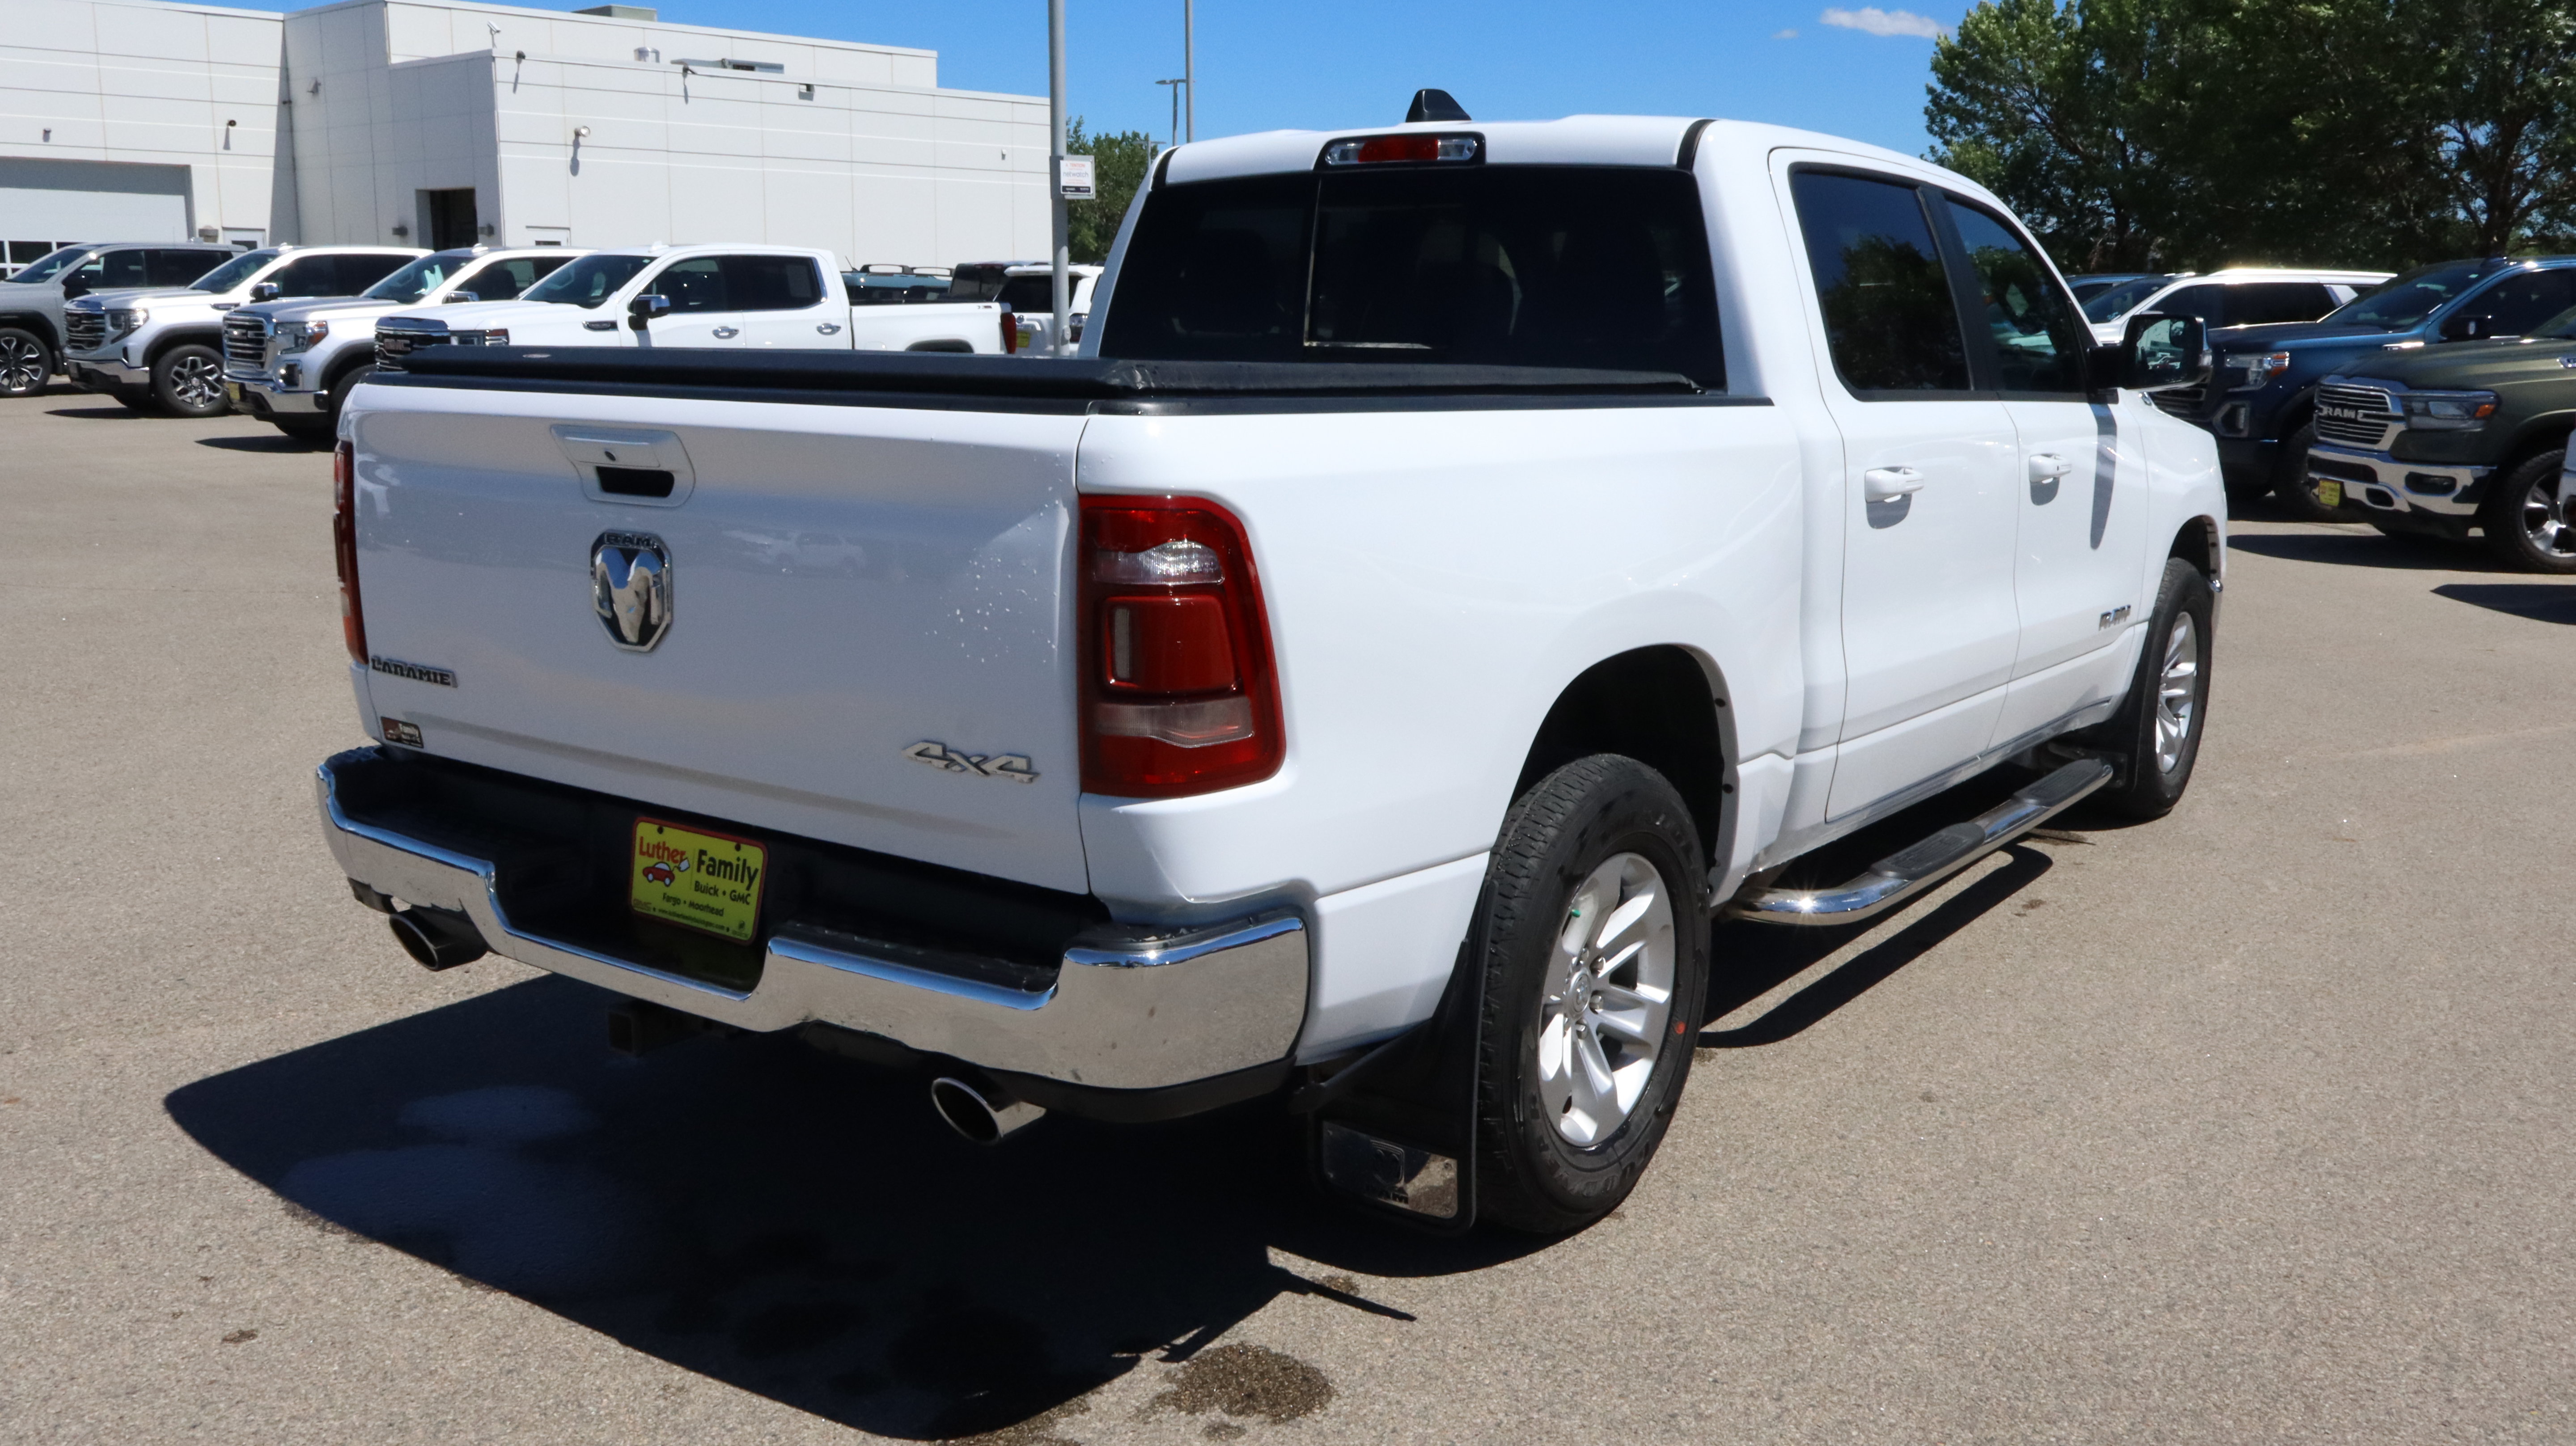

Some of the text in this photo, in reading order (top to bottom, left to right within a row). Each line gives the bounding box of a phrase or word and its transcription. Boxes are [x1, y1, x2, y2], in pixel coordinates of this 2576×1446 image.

[2322, 406, 2356, 419] RAM
[605, 533, 652, 547] RAM
[371, 656, 453, 687] LARAMIE
[639, 836, 686, 864] Luther
[696, 848, 759, 890] Family
[663, 893, 724, 916] Fargo Moorhead
[694, 881, 751, 905] Buick GMC
